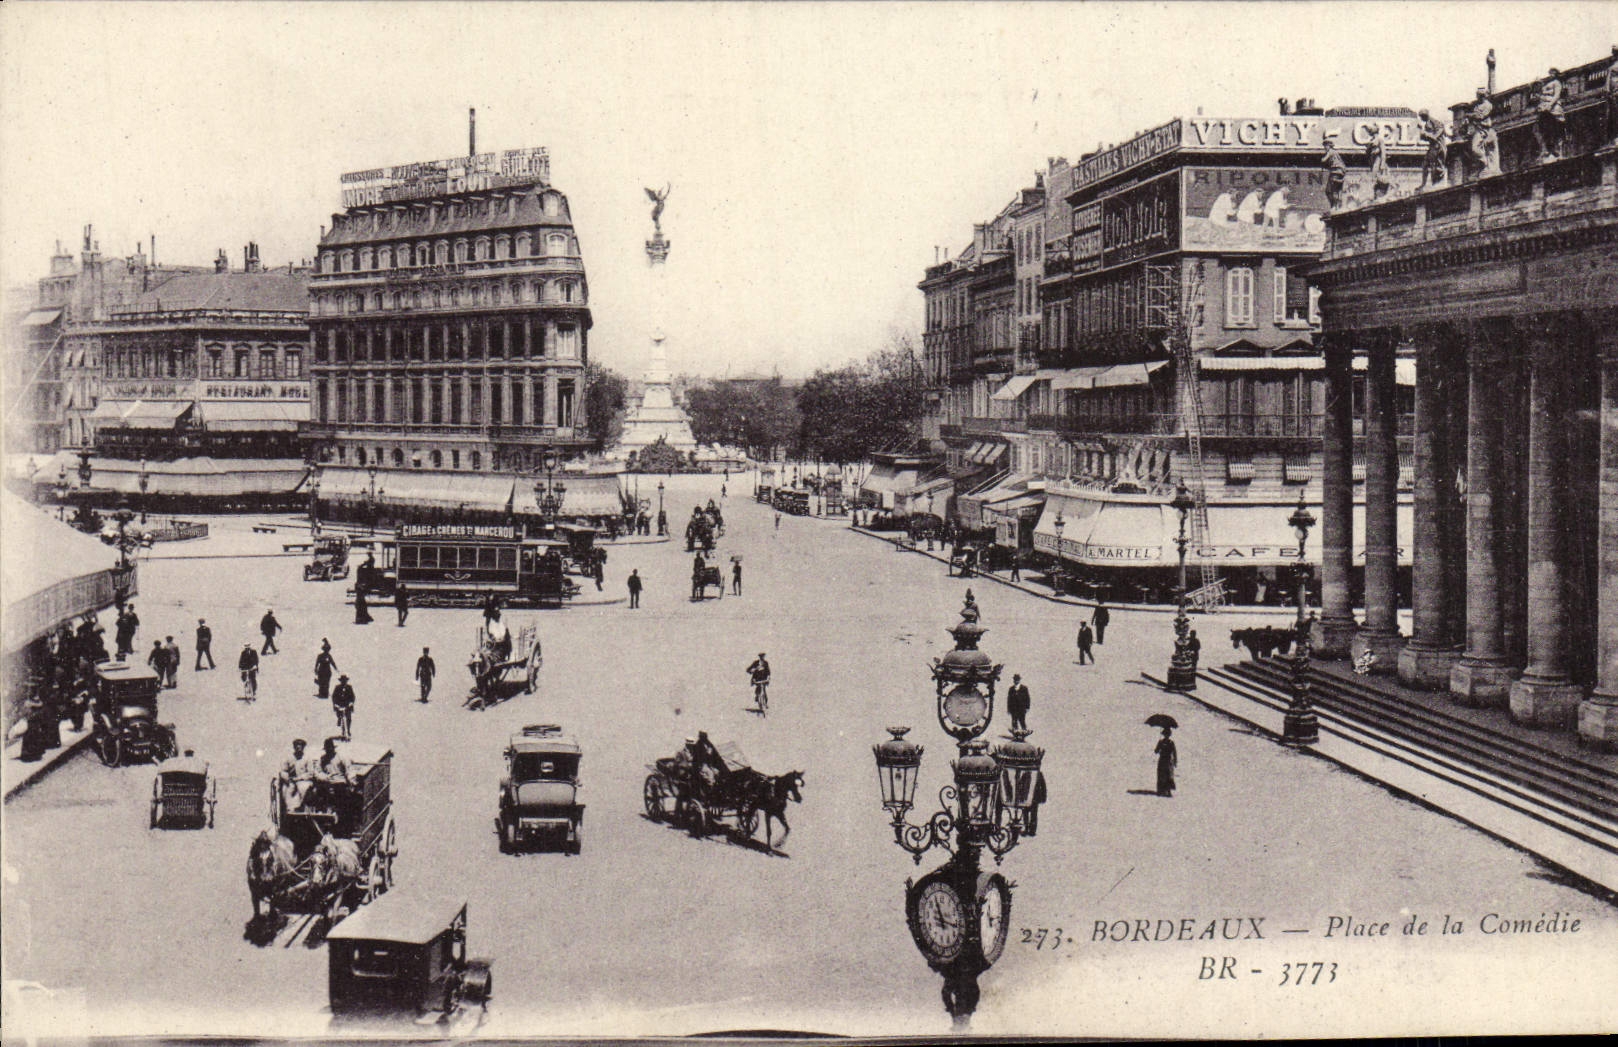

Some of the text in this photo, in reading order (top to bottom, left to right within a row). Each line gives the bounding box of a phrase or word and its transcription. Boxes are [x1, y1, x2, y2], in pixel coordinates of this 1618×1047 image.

[1190, 119, 1319, 147] VICHY
[1072, 148, 1119, 188] PASTILLES
[1193, 171, 1325, 186] RIPOLIN
[206, 384, 272, 398] RESTAURANT
[402, 525, 432, 537] CIRAGE
[1098, 547, 1151, 558] MARTEL
